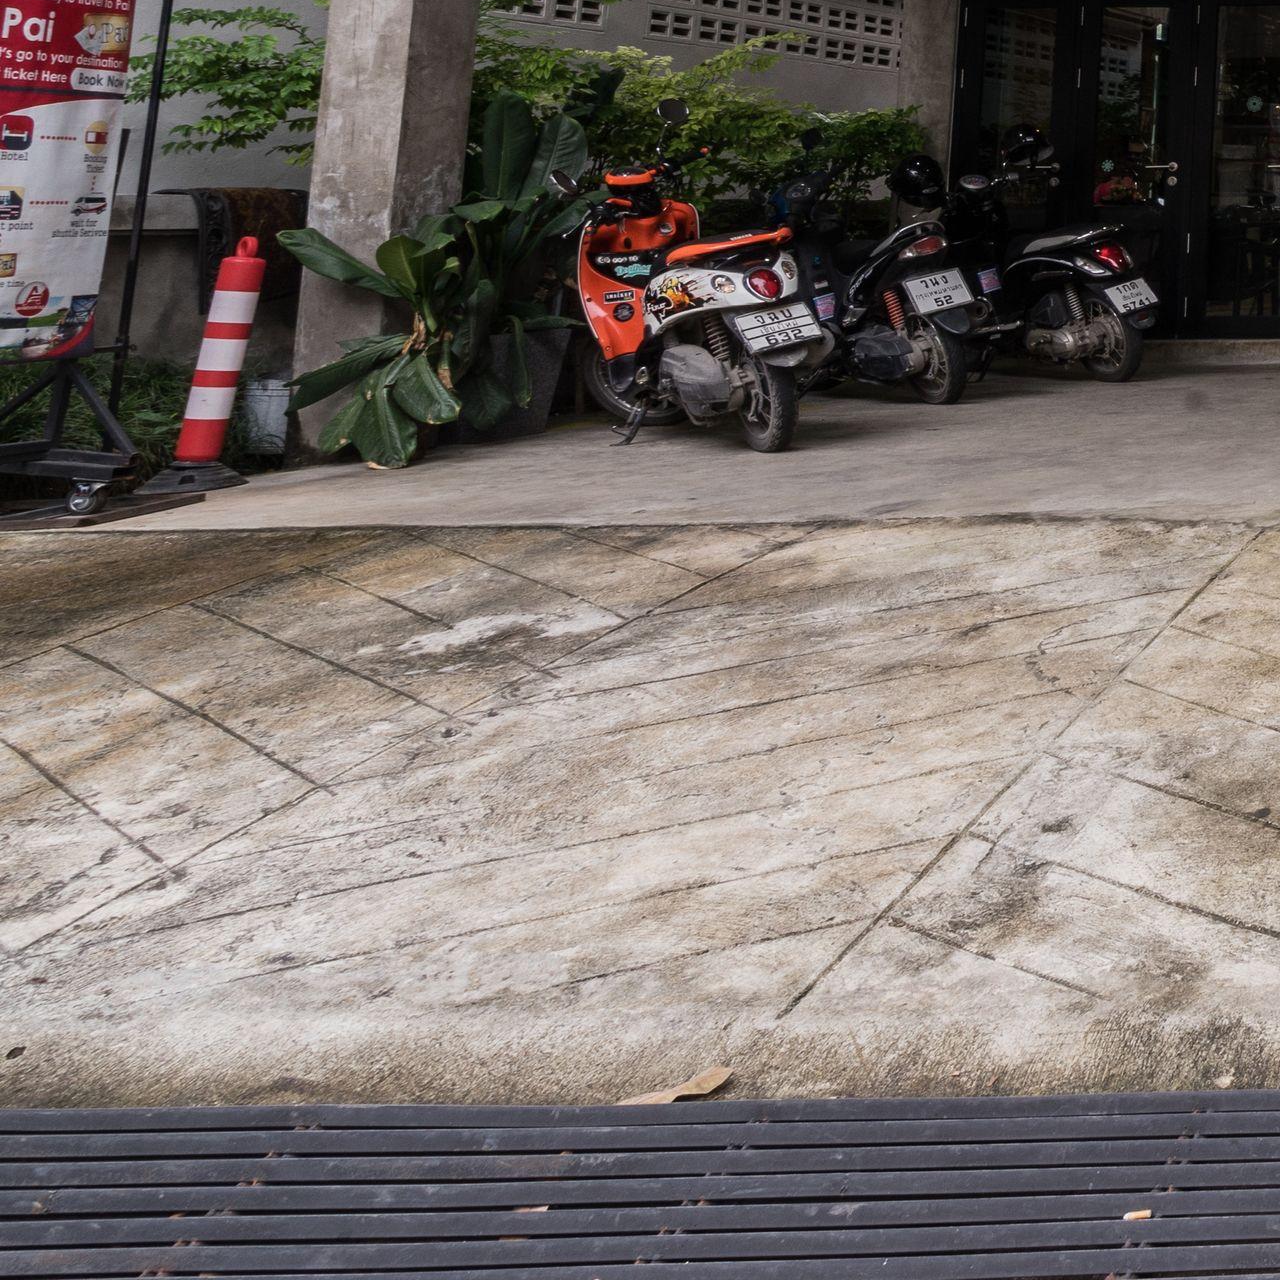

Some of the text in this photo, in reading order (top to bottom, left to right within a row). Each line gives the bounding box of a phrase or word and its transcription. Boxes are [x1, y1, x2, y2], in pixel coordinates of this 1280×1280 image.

[104, 0, 114, 9] to
[115, 0, 131, 11] Pai
[1, 6, 56, 43] Pai
[100, 21, 129, 44] Pai
[15, 50, 34, 62] go
[36, 49, 48, 62] to
[50, 52, 74, 65] your
[76, 54, 124, 69] destination
[3, 66, 39, 81] ticket
[41, 70, 67, 83] Here
[78, 72, 104, 87] Book
[1, 151, 29, 161] Hotel
[8, 222, 34, 231] point
[934, 295, 954, 307] 52
[1122, 296, 1151, 310] 5741
[765, 328, 805, 346] 632
